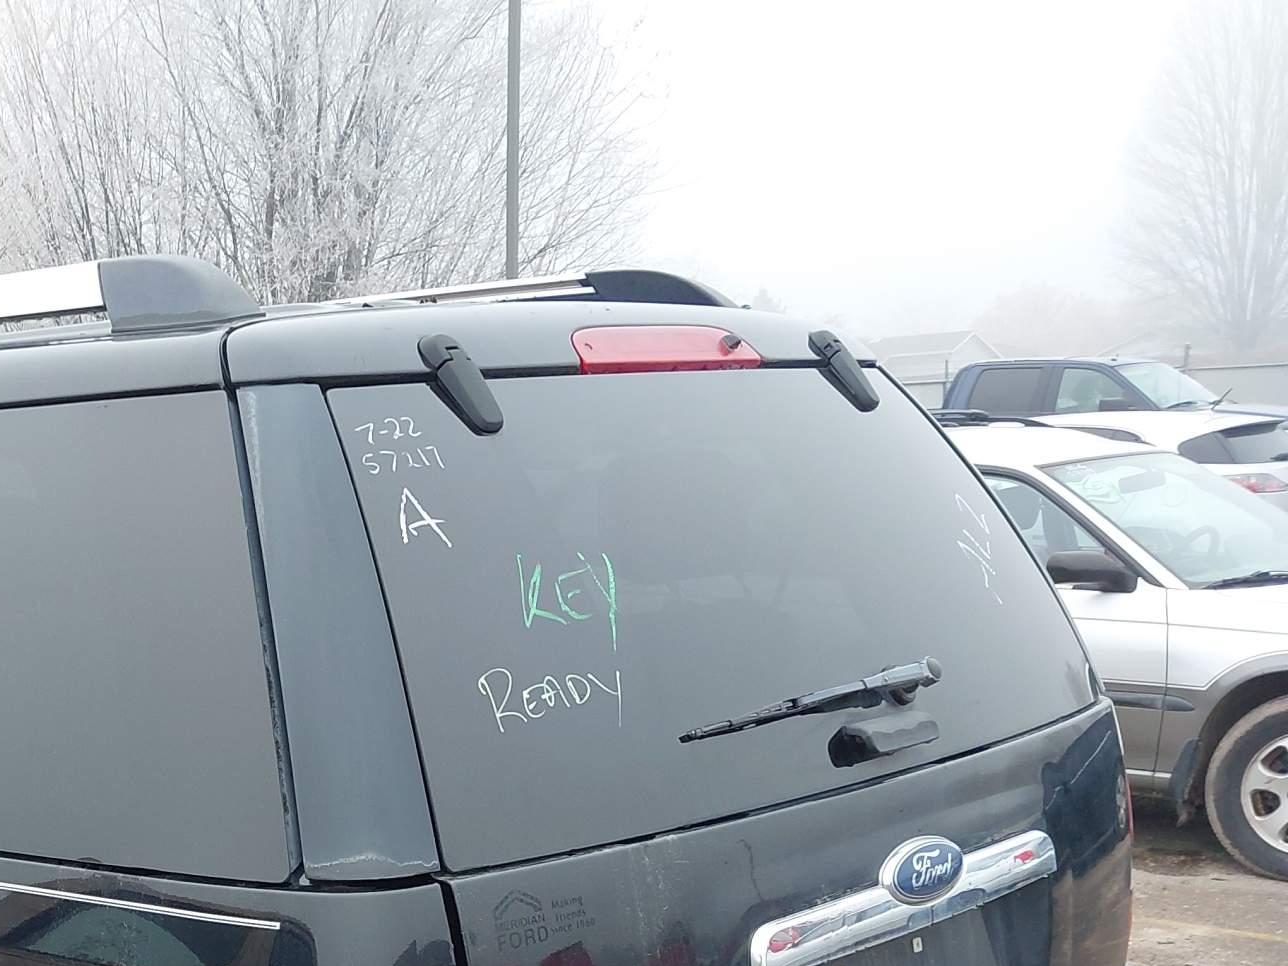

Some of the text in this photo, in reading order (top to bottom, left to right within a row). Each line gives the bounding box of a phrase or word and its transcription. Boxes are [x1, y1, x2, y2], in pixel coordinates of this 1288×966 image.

[399, 487, 453, 548] A
[516, 551, 617, 652] KEY
[477, 667, 622, 734] READY
[496, 926, 550, 953] FORD
